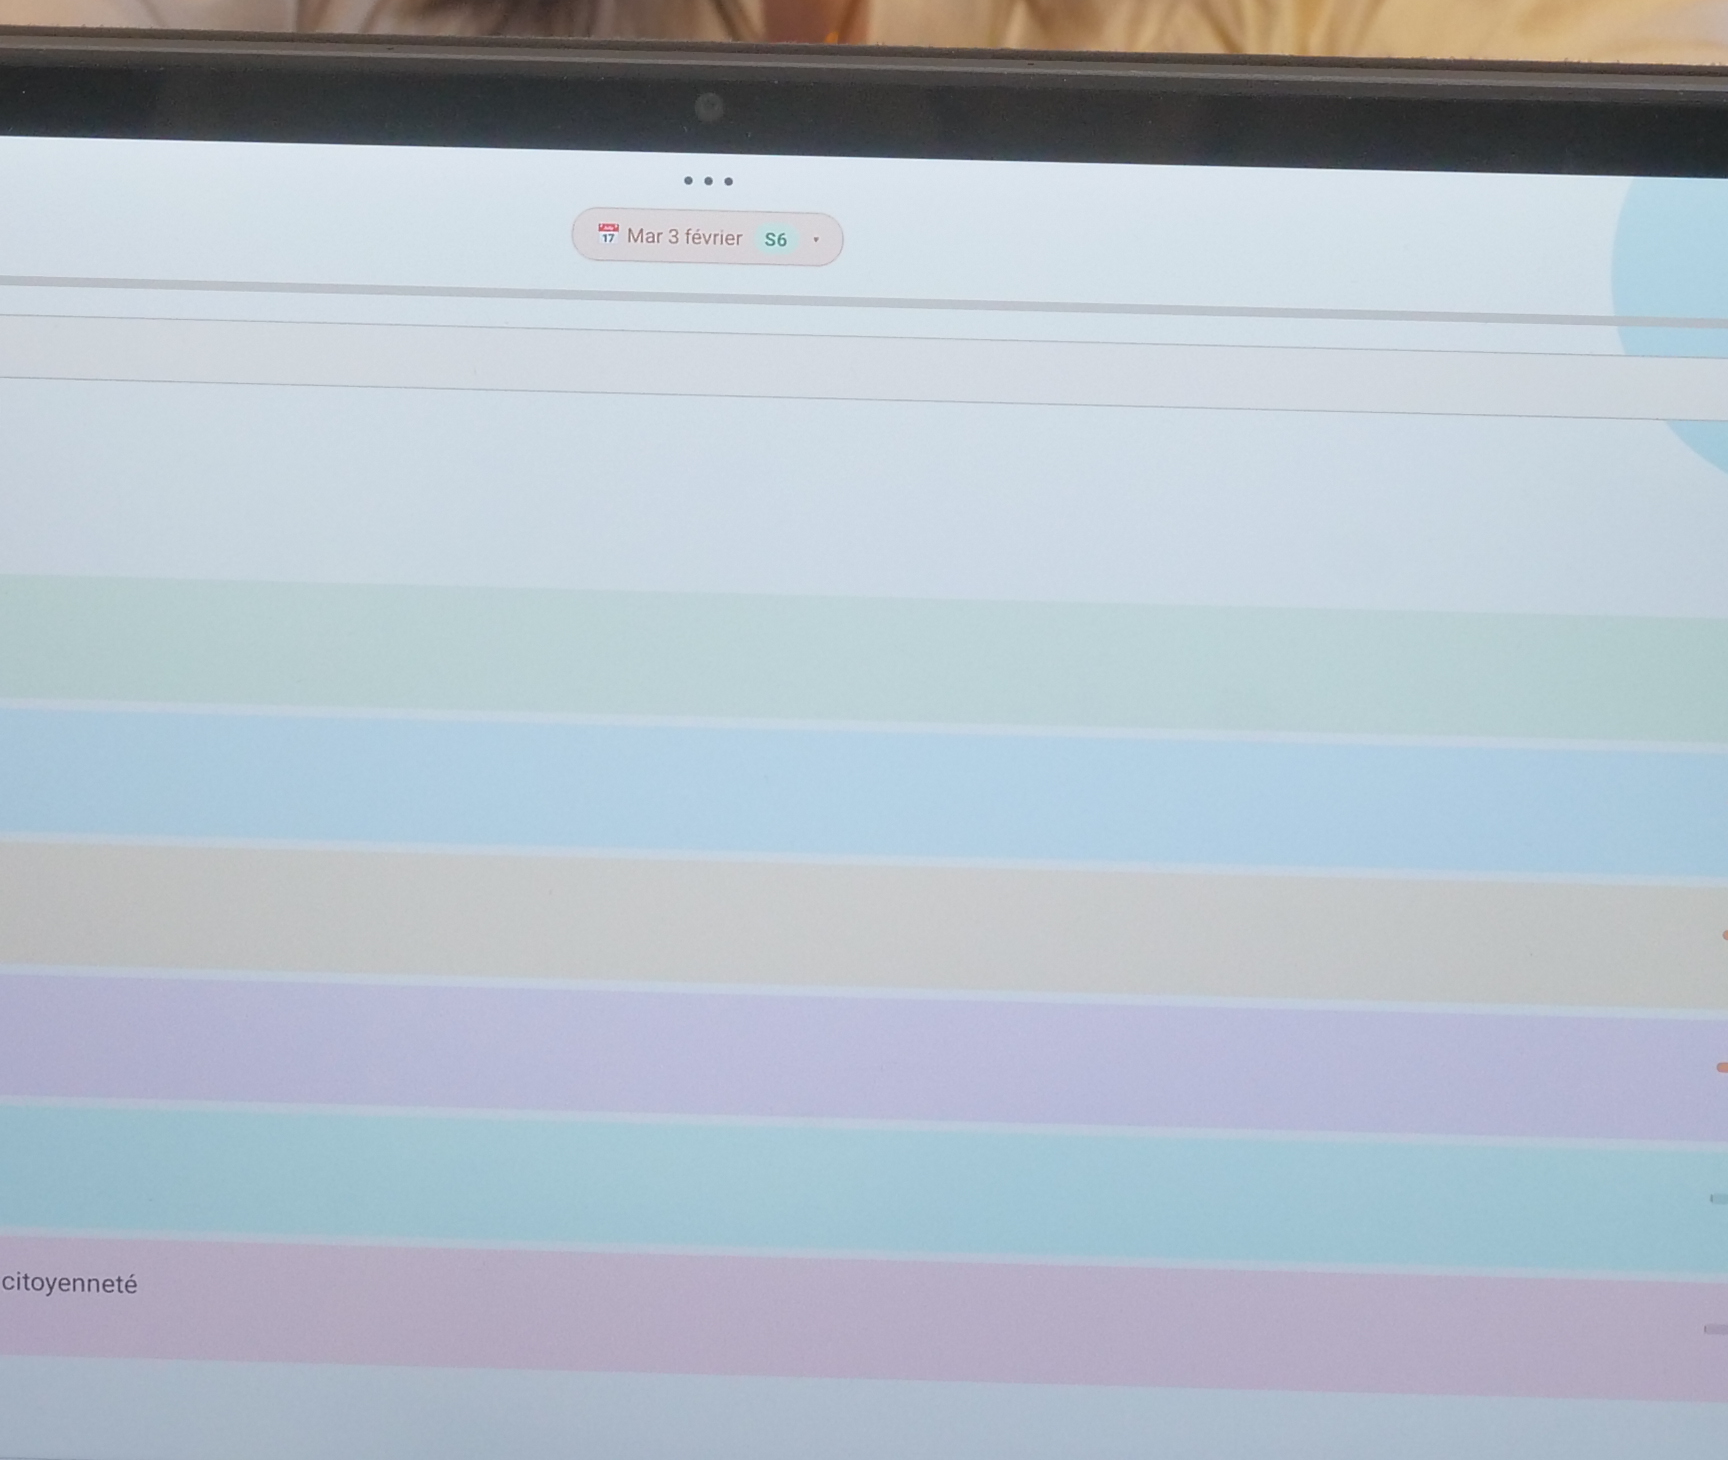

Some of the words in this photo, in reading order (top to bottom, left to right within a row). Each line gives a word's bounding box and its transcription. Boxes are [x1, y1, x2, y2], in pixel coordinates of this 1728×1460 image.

[628, 228, 663, 243] Mar
[669, 229, 679, 244] 3
[685, 228, 743, 245] février
[765, 232, 787, 247] S6
[2, 1272, 137, 1297] citoyenneté
